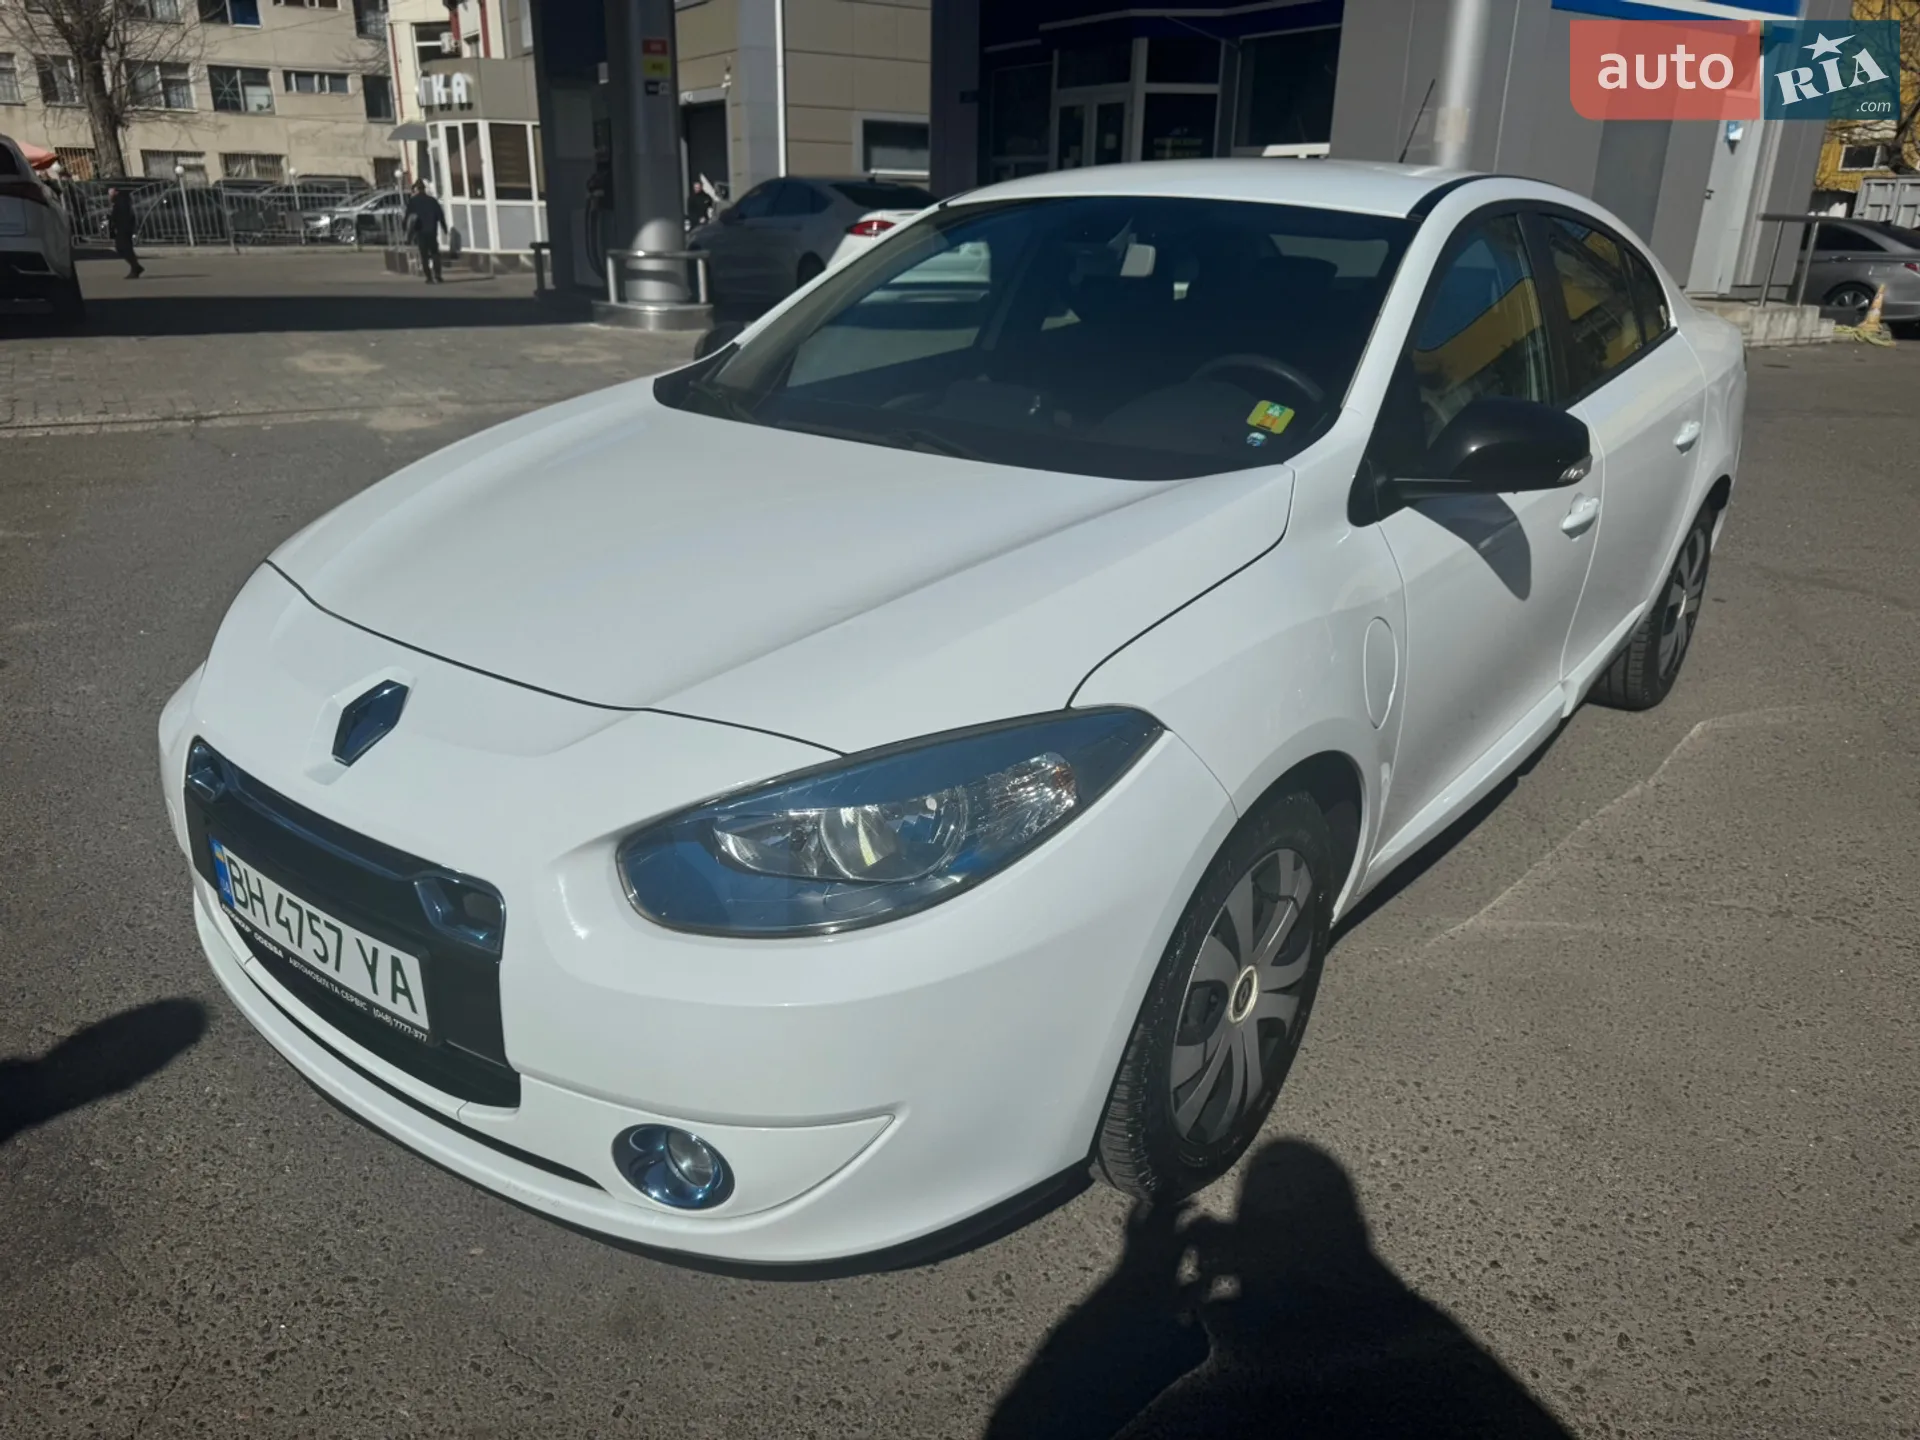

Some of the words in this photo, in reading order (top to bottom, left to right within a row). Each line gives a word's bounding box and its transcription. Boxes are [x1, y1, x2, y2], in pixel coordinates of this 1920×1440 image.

[226, 854, 271, 929] BH
[274, 892, 344, 974] 4757
[355, 937, 419, 1015] YA
